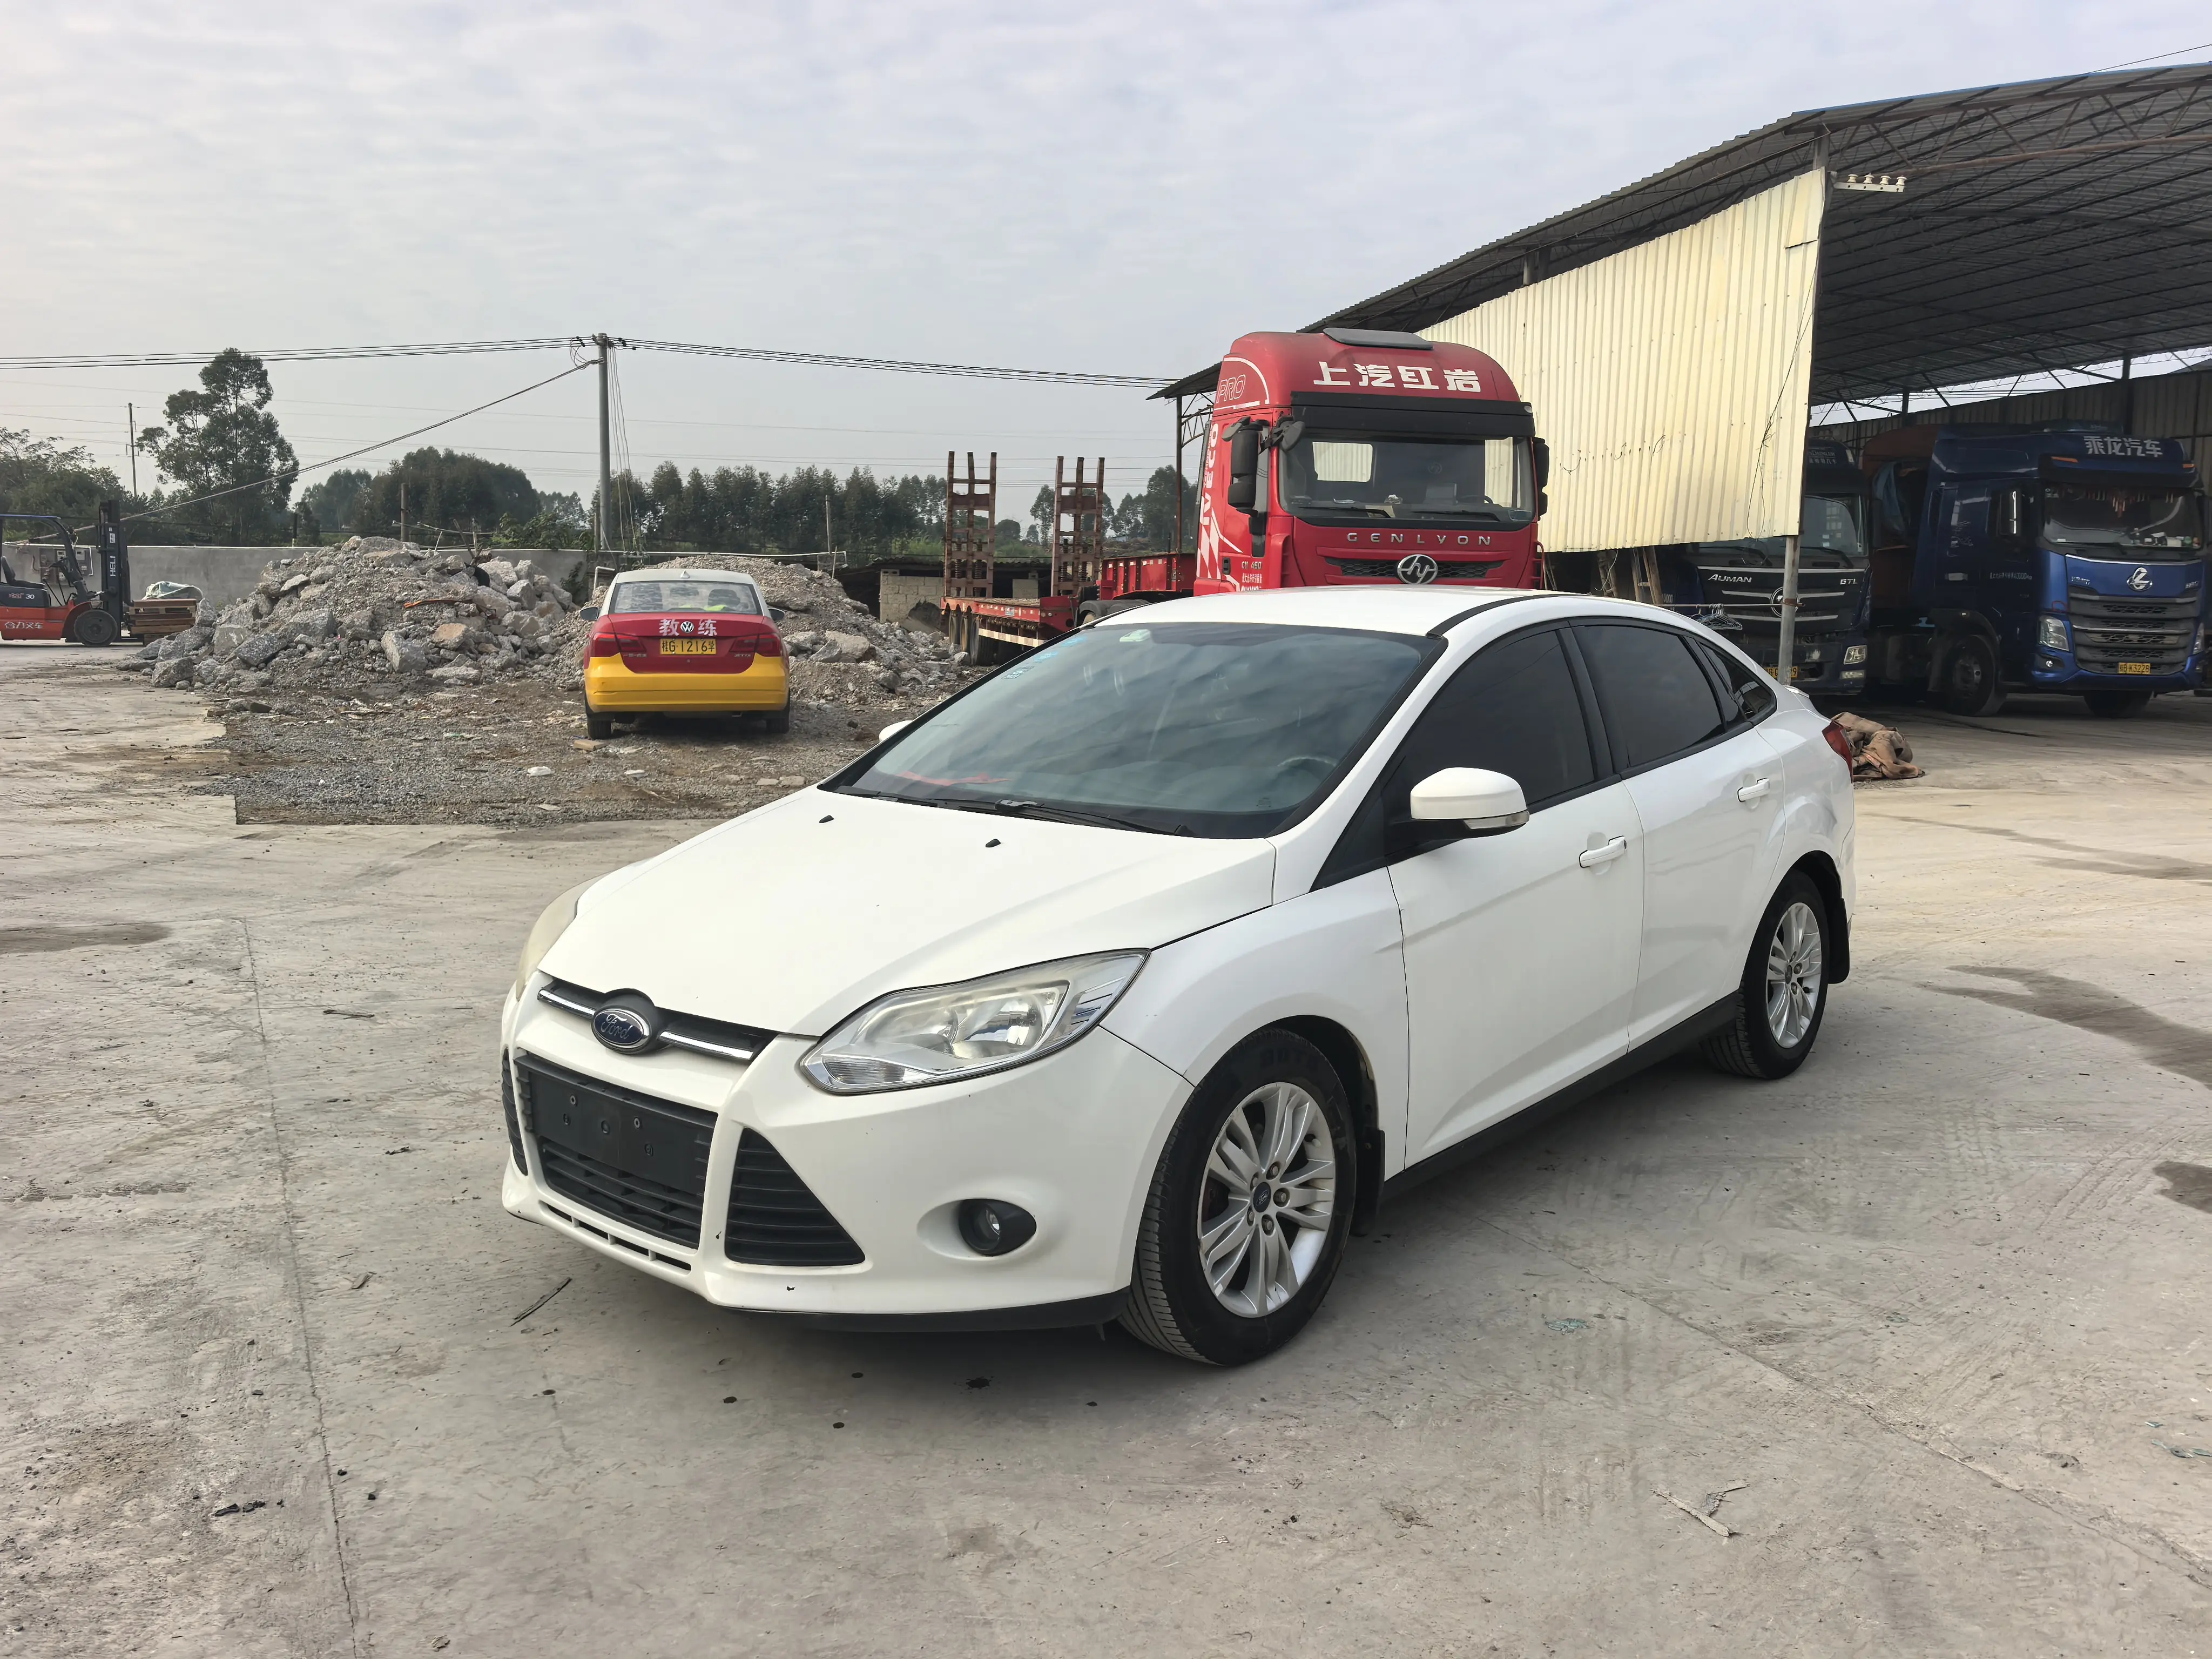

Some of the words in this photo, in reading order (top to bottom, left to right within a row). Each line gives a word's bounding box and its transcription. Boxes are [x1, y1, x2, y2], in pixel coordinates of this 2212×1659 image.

[1216, 374, 1245, 404] PRO
[1313, 361, 1481, 392] 上汽红岩
[2083, 436, 2163, 457] 乘龙汽车
[1200, 423, 1218, 525] IVECO
[1347, 532, 1491, 545] GENLYON
[1708, 574, 1752, 583] AUMAN
[601, 1014, 633, 1040] Ford
